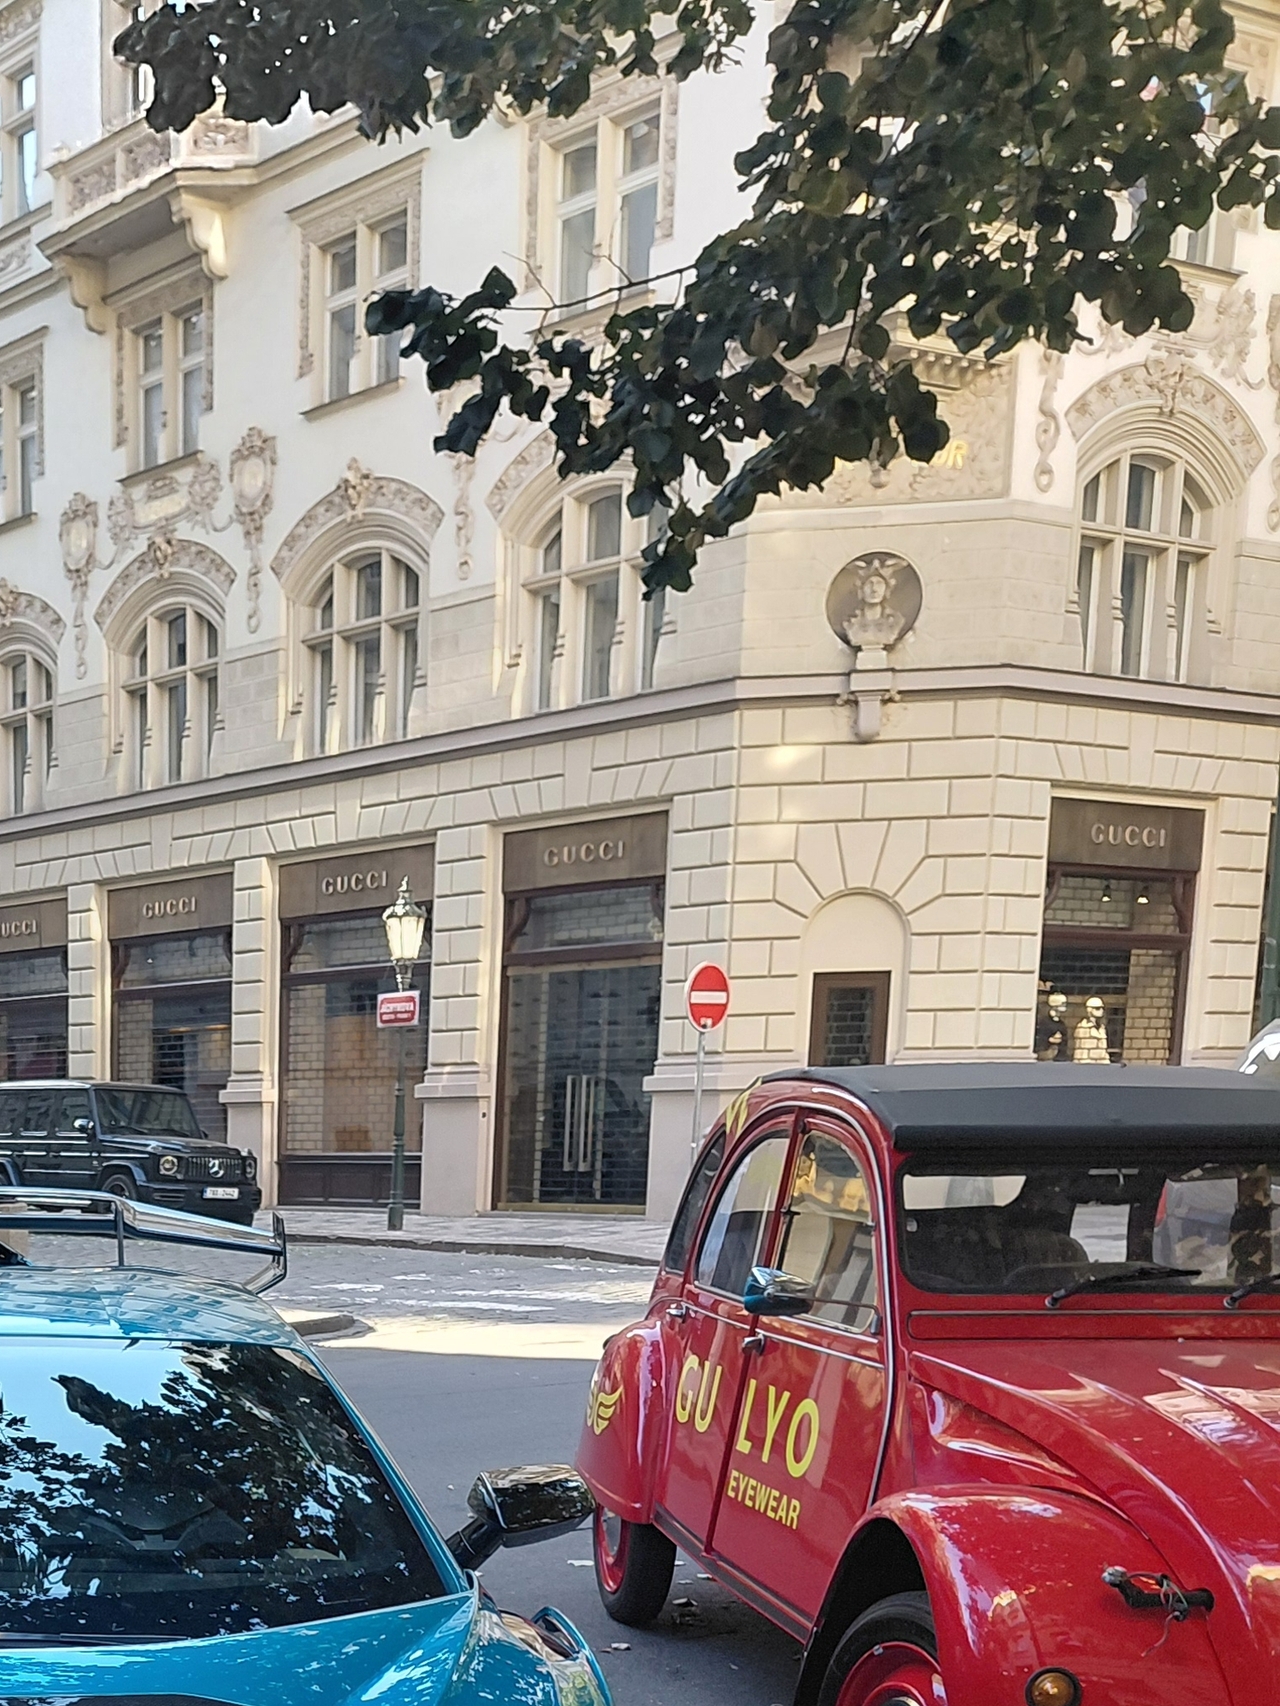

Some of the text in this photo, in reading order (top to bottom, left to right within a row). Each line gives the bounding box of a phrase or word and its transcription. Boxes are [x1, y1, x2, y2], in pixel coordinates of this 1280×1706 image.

[1091, 823, 1166, 848] GUCCI
[543, 840, 626, 867] GUCCI
[322, 870, 388, 896] GUCCI
[142, 896, 198, 920] GUCCI
[727, 1468, 800, 1530] EYEWEAR
